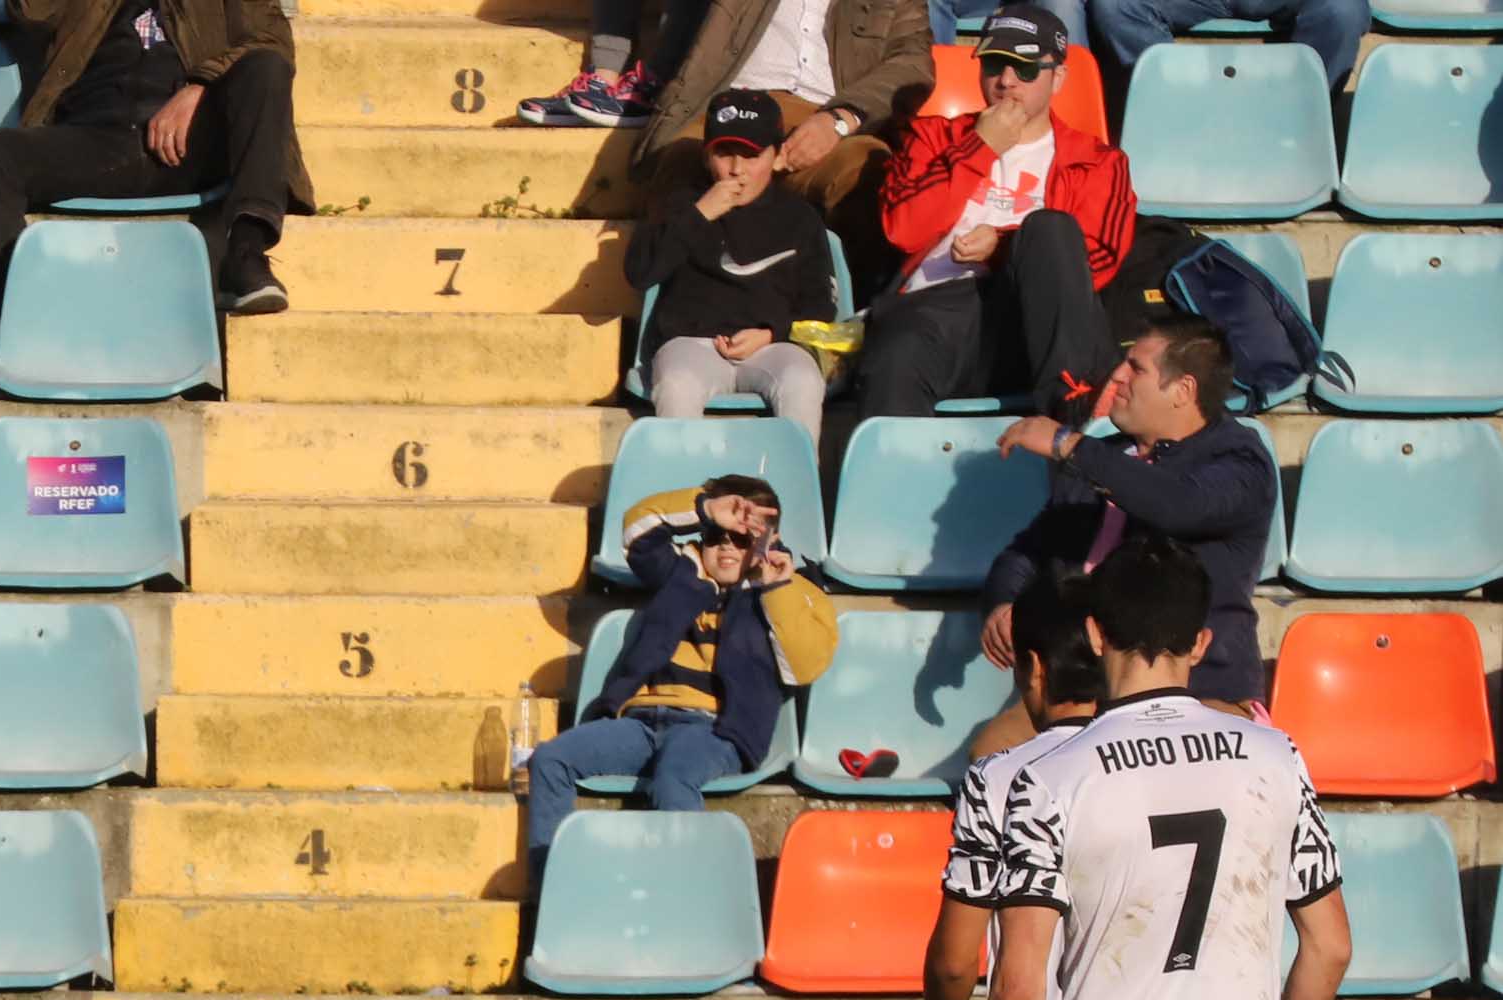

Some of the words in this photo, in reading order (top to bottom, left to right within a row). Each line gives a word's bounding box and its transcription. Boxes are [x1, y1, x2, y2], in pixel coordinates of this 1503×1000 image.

[451, 69, 485, 114] 8
[739, 110, 758, 120] LFP
[434, 248, 466, 296] 7
[391, 441, 428, 488] 6
[34, 485, 119, 497] RESERVADO
[59, 498, 95, 510] RFEF
[339, 632, 374, 678] 5
[1096, 736, 1177, 774] HUGO
[1181, 731, 1249, 763] DIAZ
[294, 829, 330, 875] 4
[1148, 808, 1227, 973] 7
